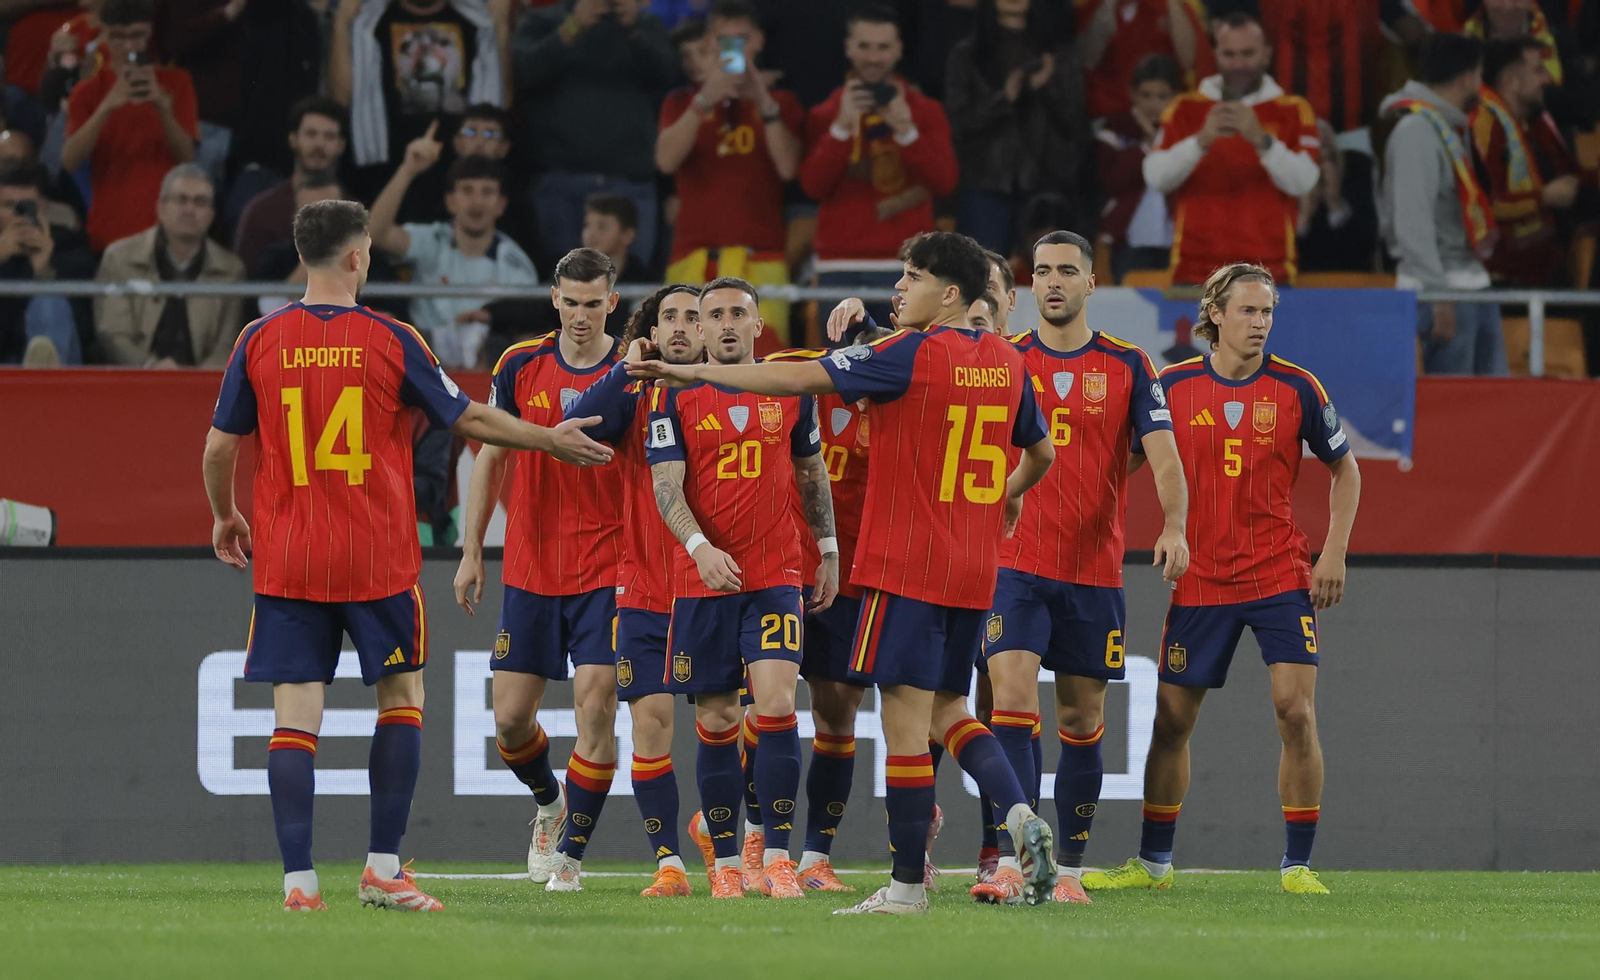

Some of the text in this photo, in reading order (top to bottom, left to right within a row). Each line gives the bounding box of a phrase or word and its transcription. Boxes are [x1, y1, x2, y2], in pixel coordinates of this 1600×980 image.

[717, 125, 755, 155] 20
[282, 347, 363, 369] LAPORTE
[281, 386, 372, 486] 14
[1050, 407, 1071, 446] 6
[717, 440, 762, 480] 20
[939, 405, 1007, 504] 15
[1224, 438, 1243, 477] 5
[761, 613, 800, 651] 20
[1105, 629, 1124, 669] 6
[1300, 616, 1318, 654] 5
